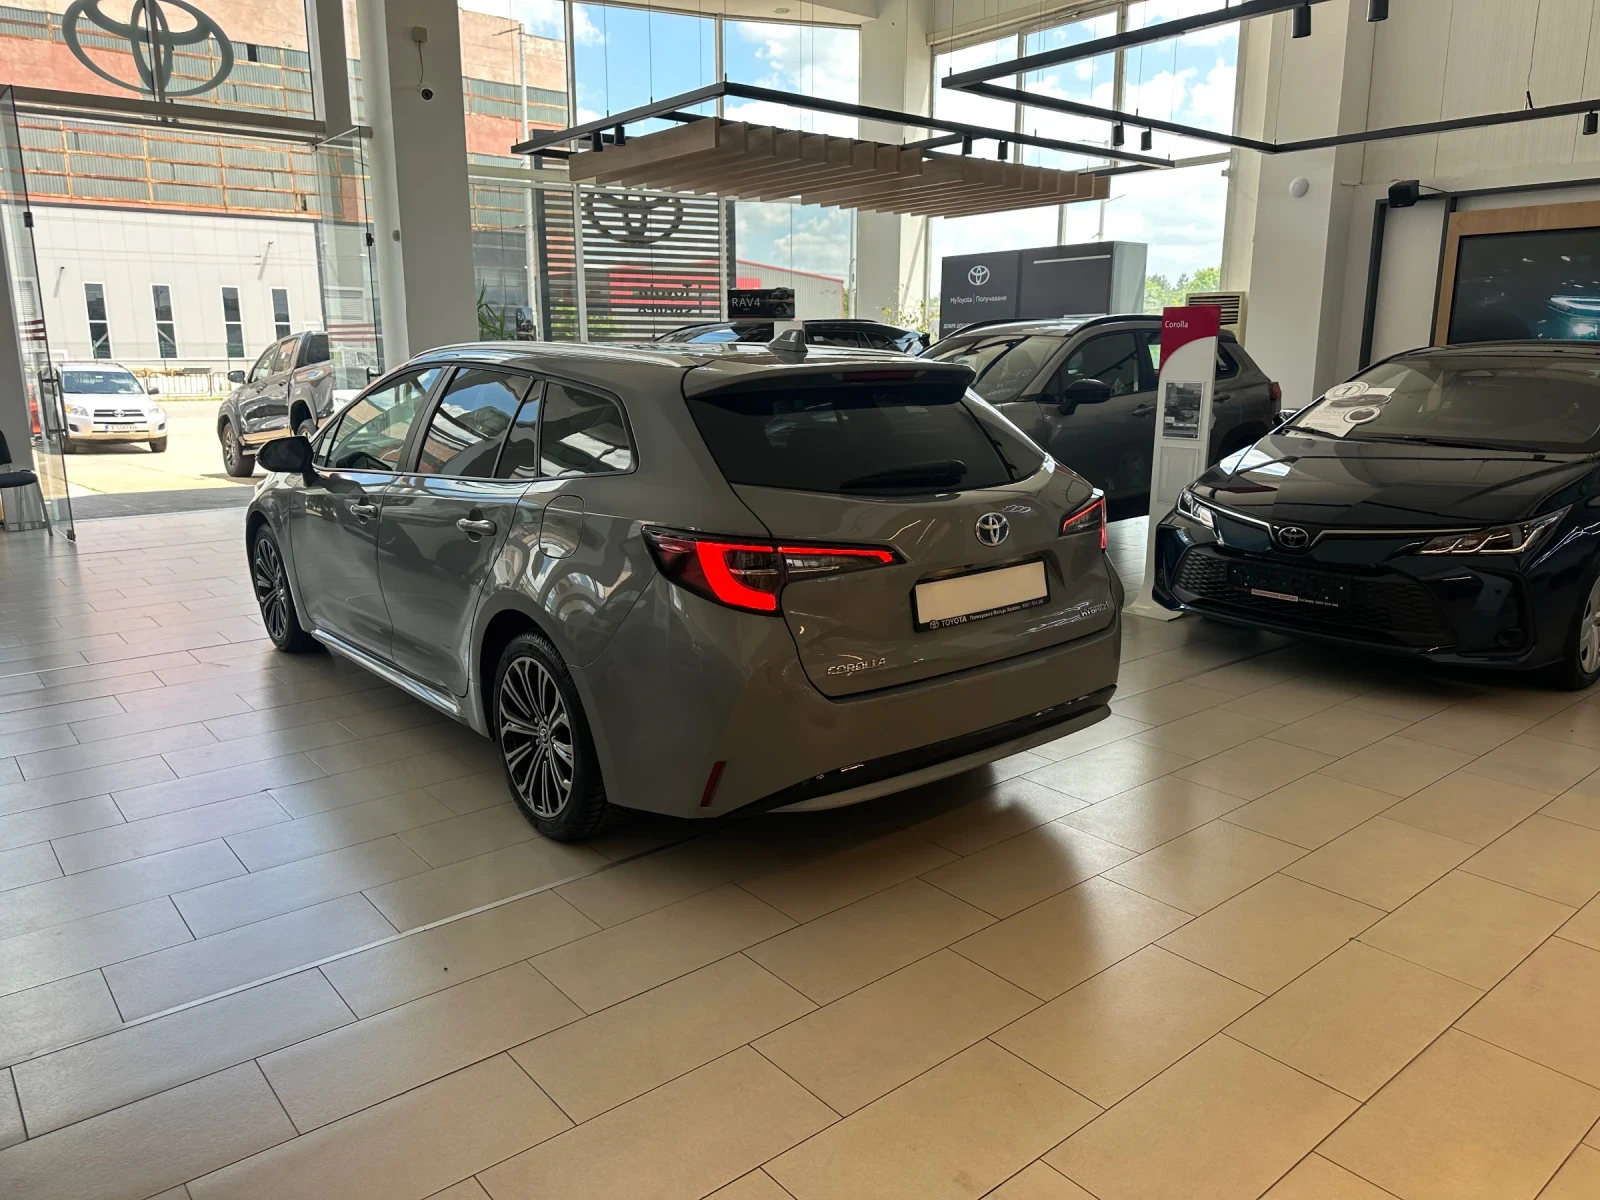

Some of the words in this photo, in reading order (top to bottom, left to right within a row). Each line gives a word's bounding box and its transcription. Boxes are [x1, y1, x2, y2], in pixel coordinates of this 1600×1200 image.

[731, 297, 761, 307] RAV4
[950, 296, 973, 305] MyToyota
[975, 295, 1008, 303] Получаване
[1164, 320, 1189, 328] Corolla
[941, 615, 967, 627] TOYOTA
[827, 657, 886, 676] COROLLA
